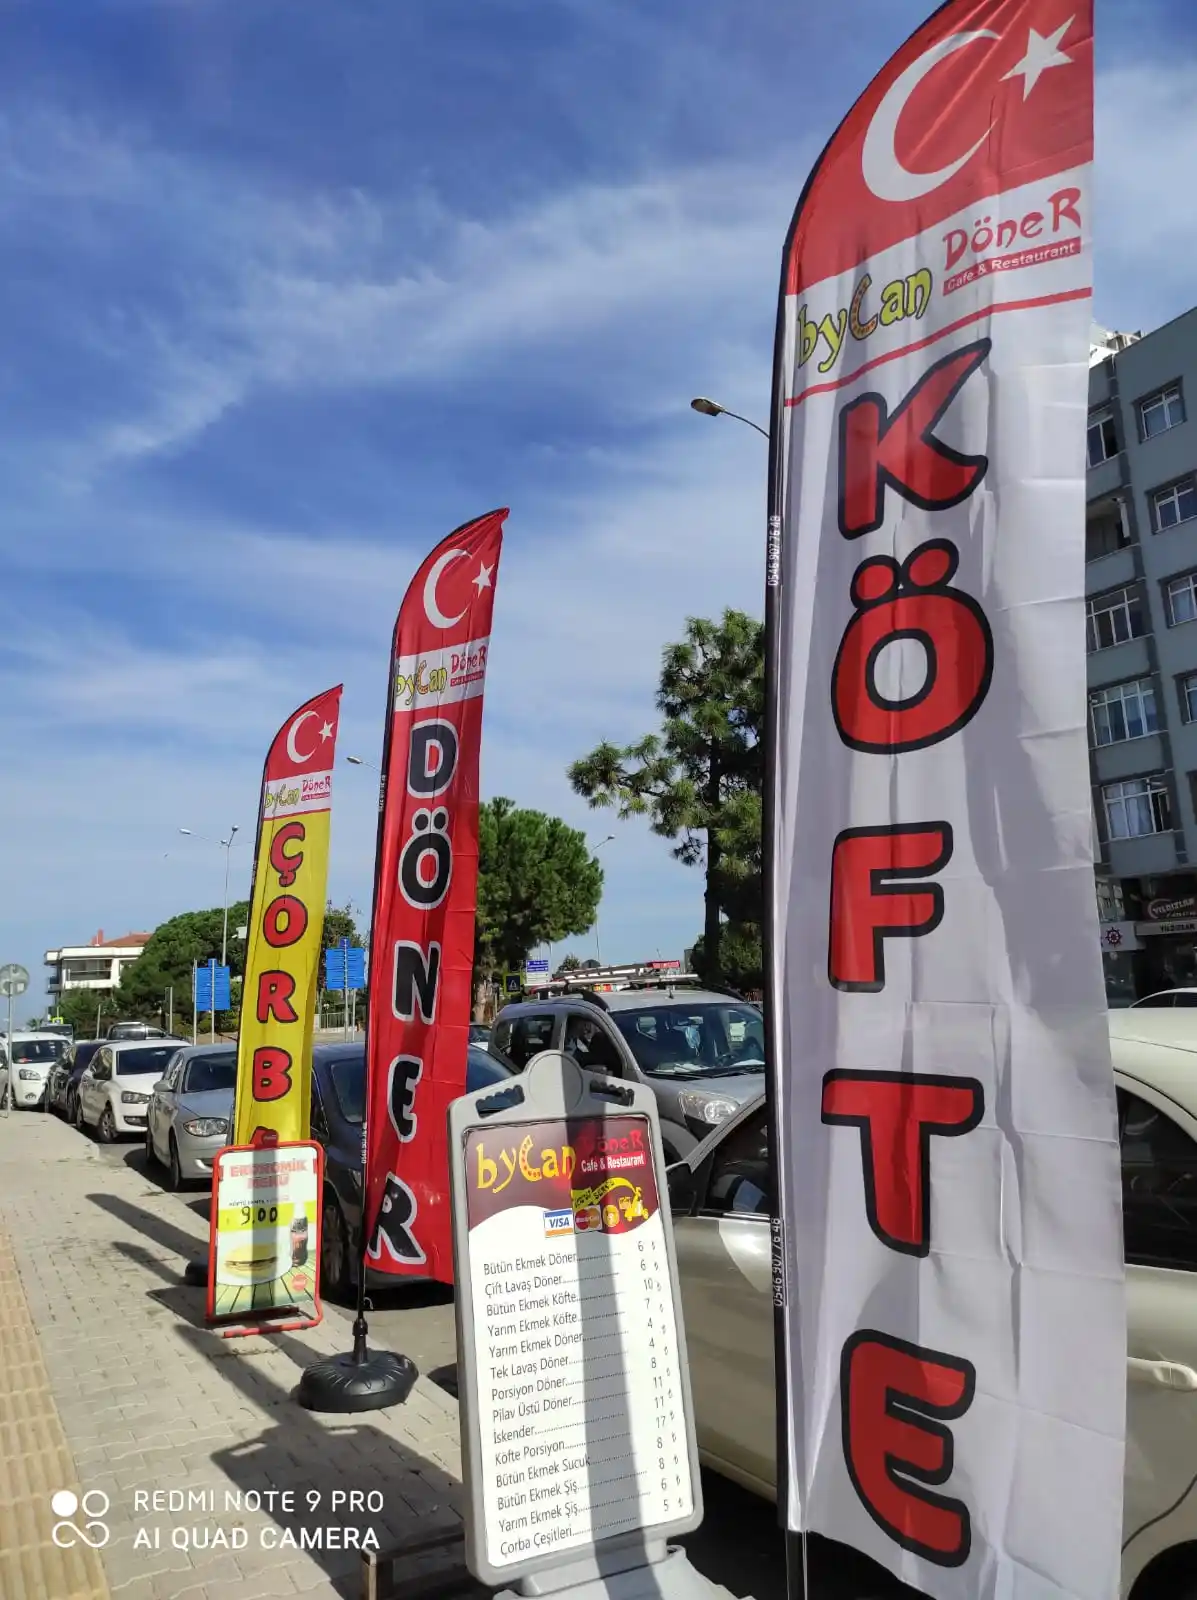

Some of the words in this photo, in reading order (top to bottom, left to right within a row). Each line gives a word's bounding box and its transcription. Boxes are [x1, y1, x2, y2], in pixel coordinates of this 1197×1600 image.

[947, 272, 975, 291] Cafe
[978, 262, 987, 276] &
[991, 242, 1076, 271] Restaurant
[798, 267, 932, 373] byCan
[821, 338, 995, 1567] KÖFTE
[368, 717, 458, 1265] DÖNER
[476, 1134, 577, 1194] byCan
[581, 1159, 598, 1173] Cafe
[600, 1157, 606, 1170] &
[607, 1153, 645, 1169] Restaurant
[550, 1217, 570, 1228] VISA
[484, 1261, 512, 1276] Bütün
[516, 1255, 546, 1270] Ekmek
[549, 1253, 577, 1266] Döner
[638, 1240, 644, 1252] 6
[485, 1283, 502, 1298] Çift
[506, 1280, 531, 1292] Lavaş
[534, 1275, 562, 1288] Döner
[640, 1260, 646, 1270] 6
[486, 1302, 516, 1316] Bütün
[519, 1296, 550, 1312] Ekmek
[552, 1290, 577, 1305] Köfte
[644, 1278, 653, 1290] 10
[488, 1324, 516, 1336] Yarım
[520, 1316, 550, 1332] Ekmek
[553, 1312, 578, 1326] Köfte
[644, 1298, 650, 1308] 7
[489, 1344, 518, 1358] Yarım
[520, 1336, 552, 1353] Ekmek
[554, 1333, 583, 1346] Döner
[648, 1316, 652, 1328] 4
[490, 1365, 508, 1380] Tek
[512, 1363, 537, 1375] Lavaş
[540, 1356, 568, 1370] Döner
[648, 1337, 654, 1348] 4
[492, 1384, 534, 1400] Porsiyon
[537, 1377, 566, 1392] Döner
[651, 1357, 656, 1368] 8
[493, 1408, 515, 1422] Pilav
[518, 1401, 540, 1416] Üstü
[544, 1396, 572, 1412] Döner
[654, 1376, 662, 1388] 11
[494, 1425, 534, 1444] İskender
[655, 1396, 664, 1408] 11
[495, 1449, 520, 1466] Köfte
[524, 1440, 565, 1457] Porsiyon
[656, 1416, 666, 1428] 17
[496, 1472, 524, 1488] Bütün
[528, 1460, 560, 1480] Ekmek
[562, 1452, 590, 1472] Sucuk
[656, 1436, 662, 1448] 8
[498, 1493, 526, 1510] Bütün
[530, 1484, 562, 1502] Ekmek
[564, 1479, 578, 1495] Şiş
[658, 1458, 664, 1470] 8
[499, 1516, 528, 1532] Yarım
[530, 1504, 562, 1524] Ekmek
[564, 1501, 578, 1518] Şiş
[661, 1478, 666, 1490] 6
[500, 1539, 530, 1558] Çorba
[534, 1524, 572, 1548] Çeşitleri
[664, 1499, 668, 1512] 5
